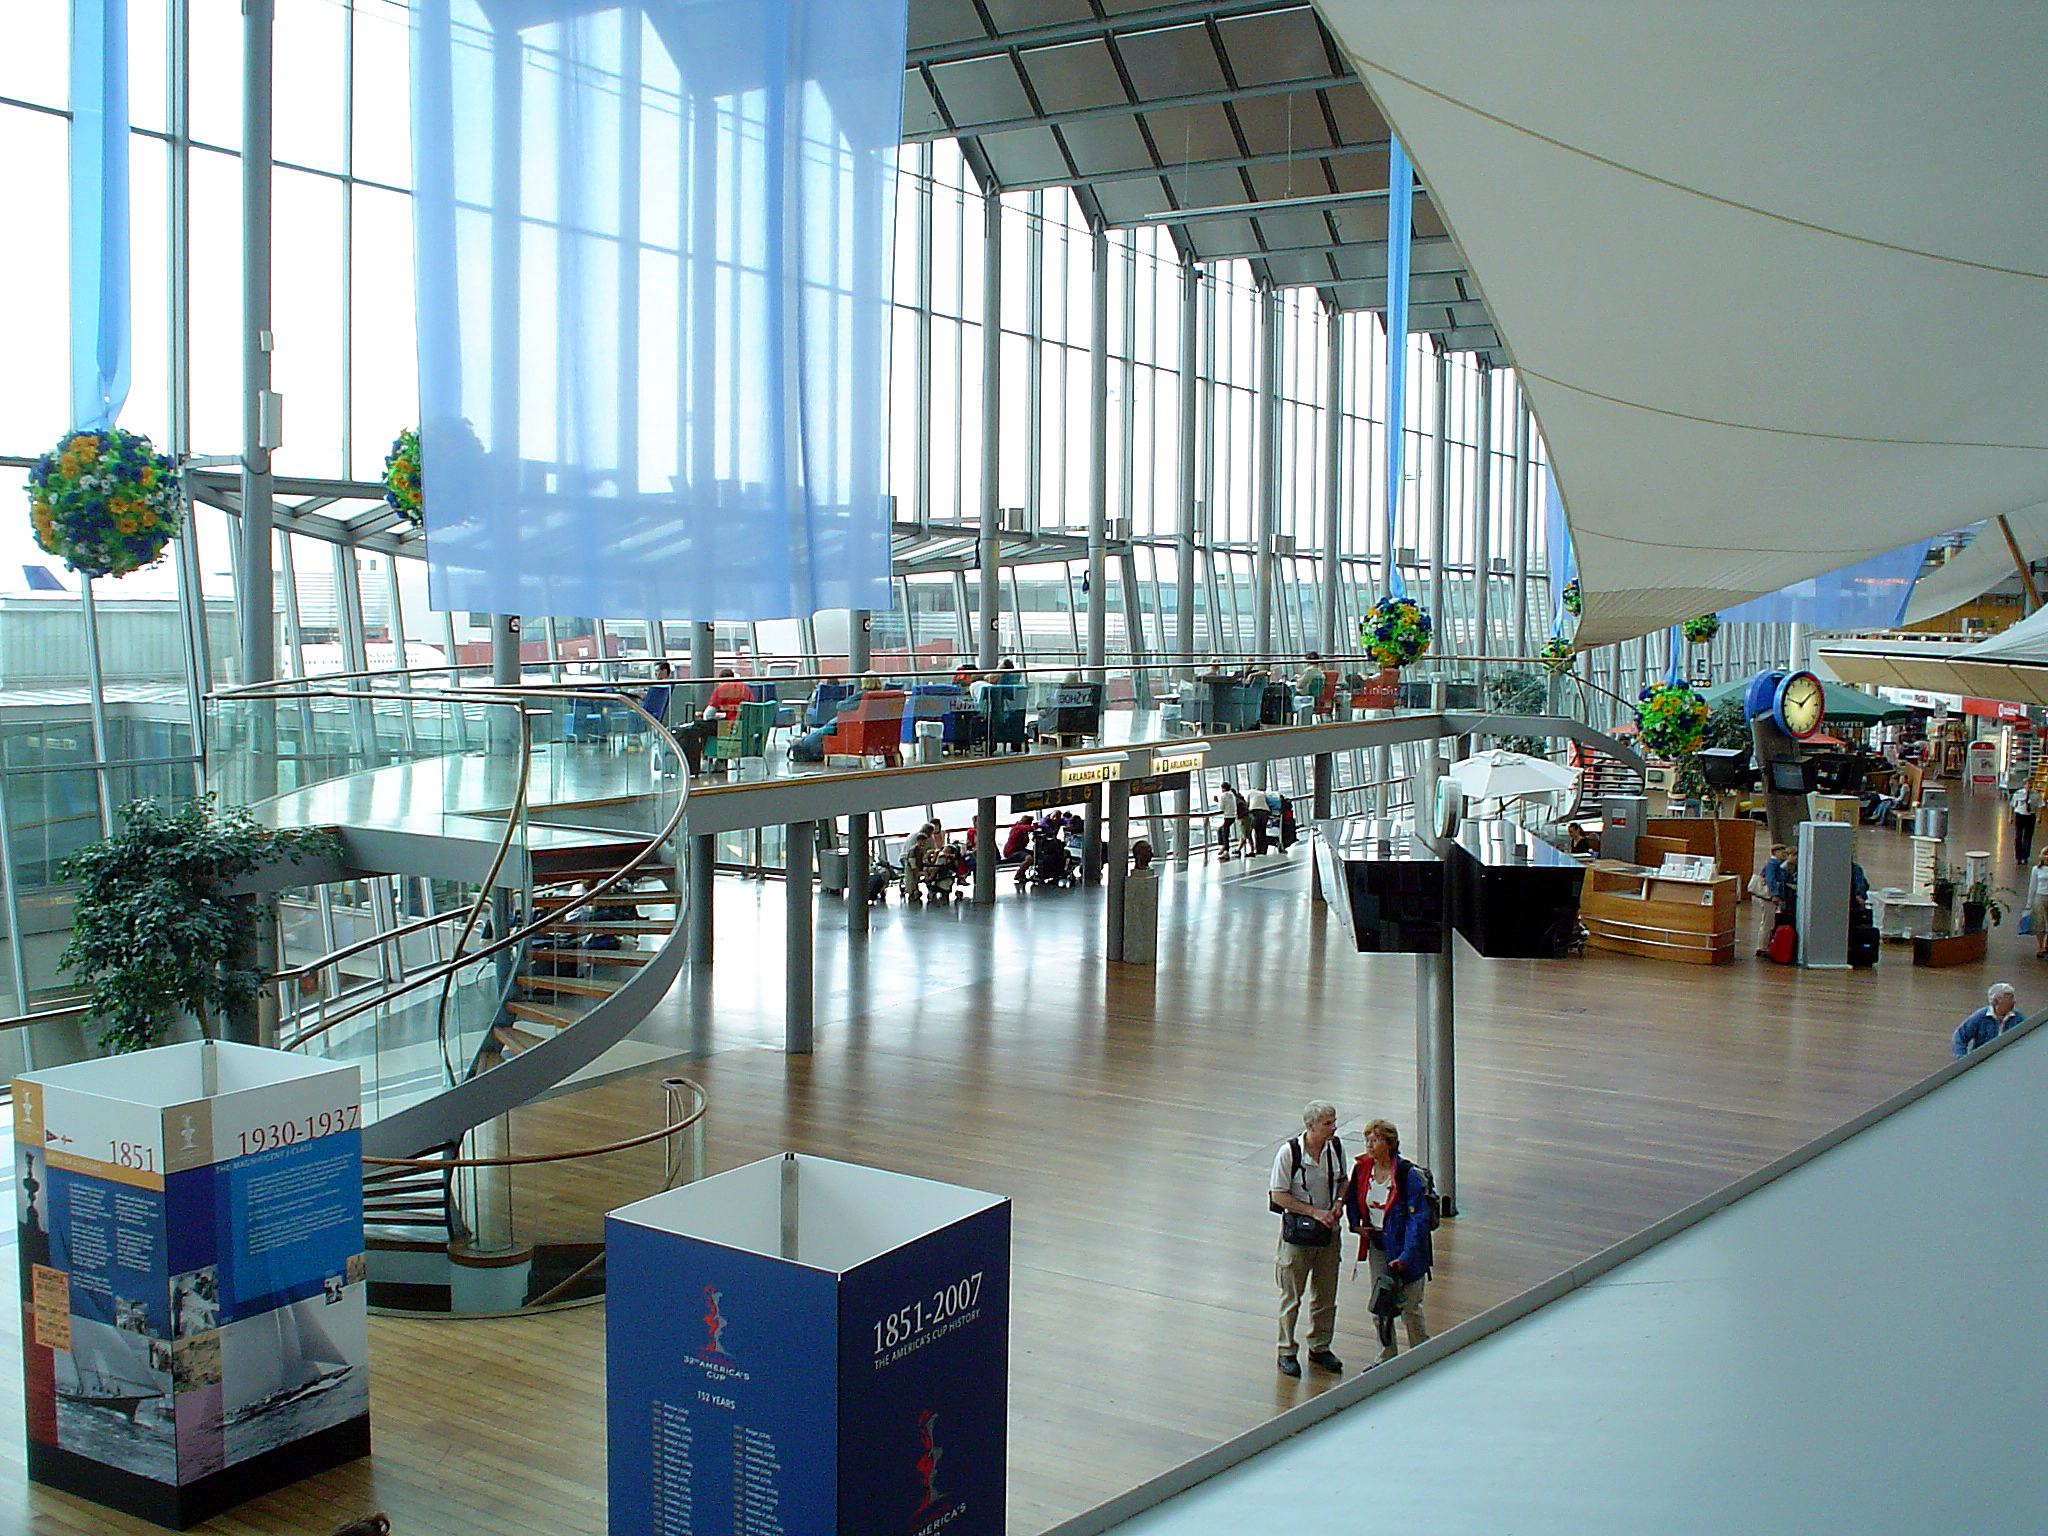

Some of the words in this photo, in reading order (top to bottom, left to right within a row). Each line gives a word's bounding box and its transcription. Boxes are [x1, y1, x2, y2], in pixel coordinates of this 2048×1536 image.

[1068, 770, 1096, 782] ARLANDA
[1170, 759, 1193, 770] ARLANDA
[237, 1104, 359, 1157] 1930-1937
[109, 1141, 156, 1173] 1851
[873, 1271, 983, 1355] 1851-2007
[874, 1353, 890, 1370] THE
[891, 1333, 931, 1362] AMERICA'S
[931, 1324, 948, 1340] CUP
[948, 1308, 982, 1333] HISTORY
[706, 1370, 727, 1381] CUP
[696, 1390, 710, 1402] 152
[712, 1395, 736, 1410] YEARS
